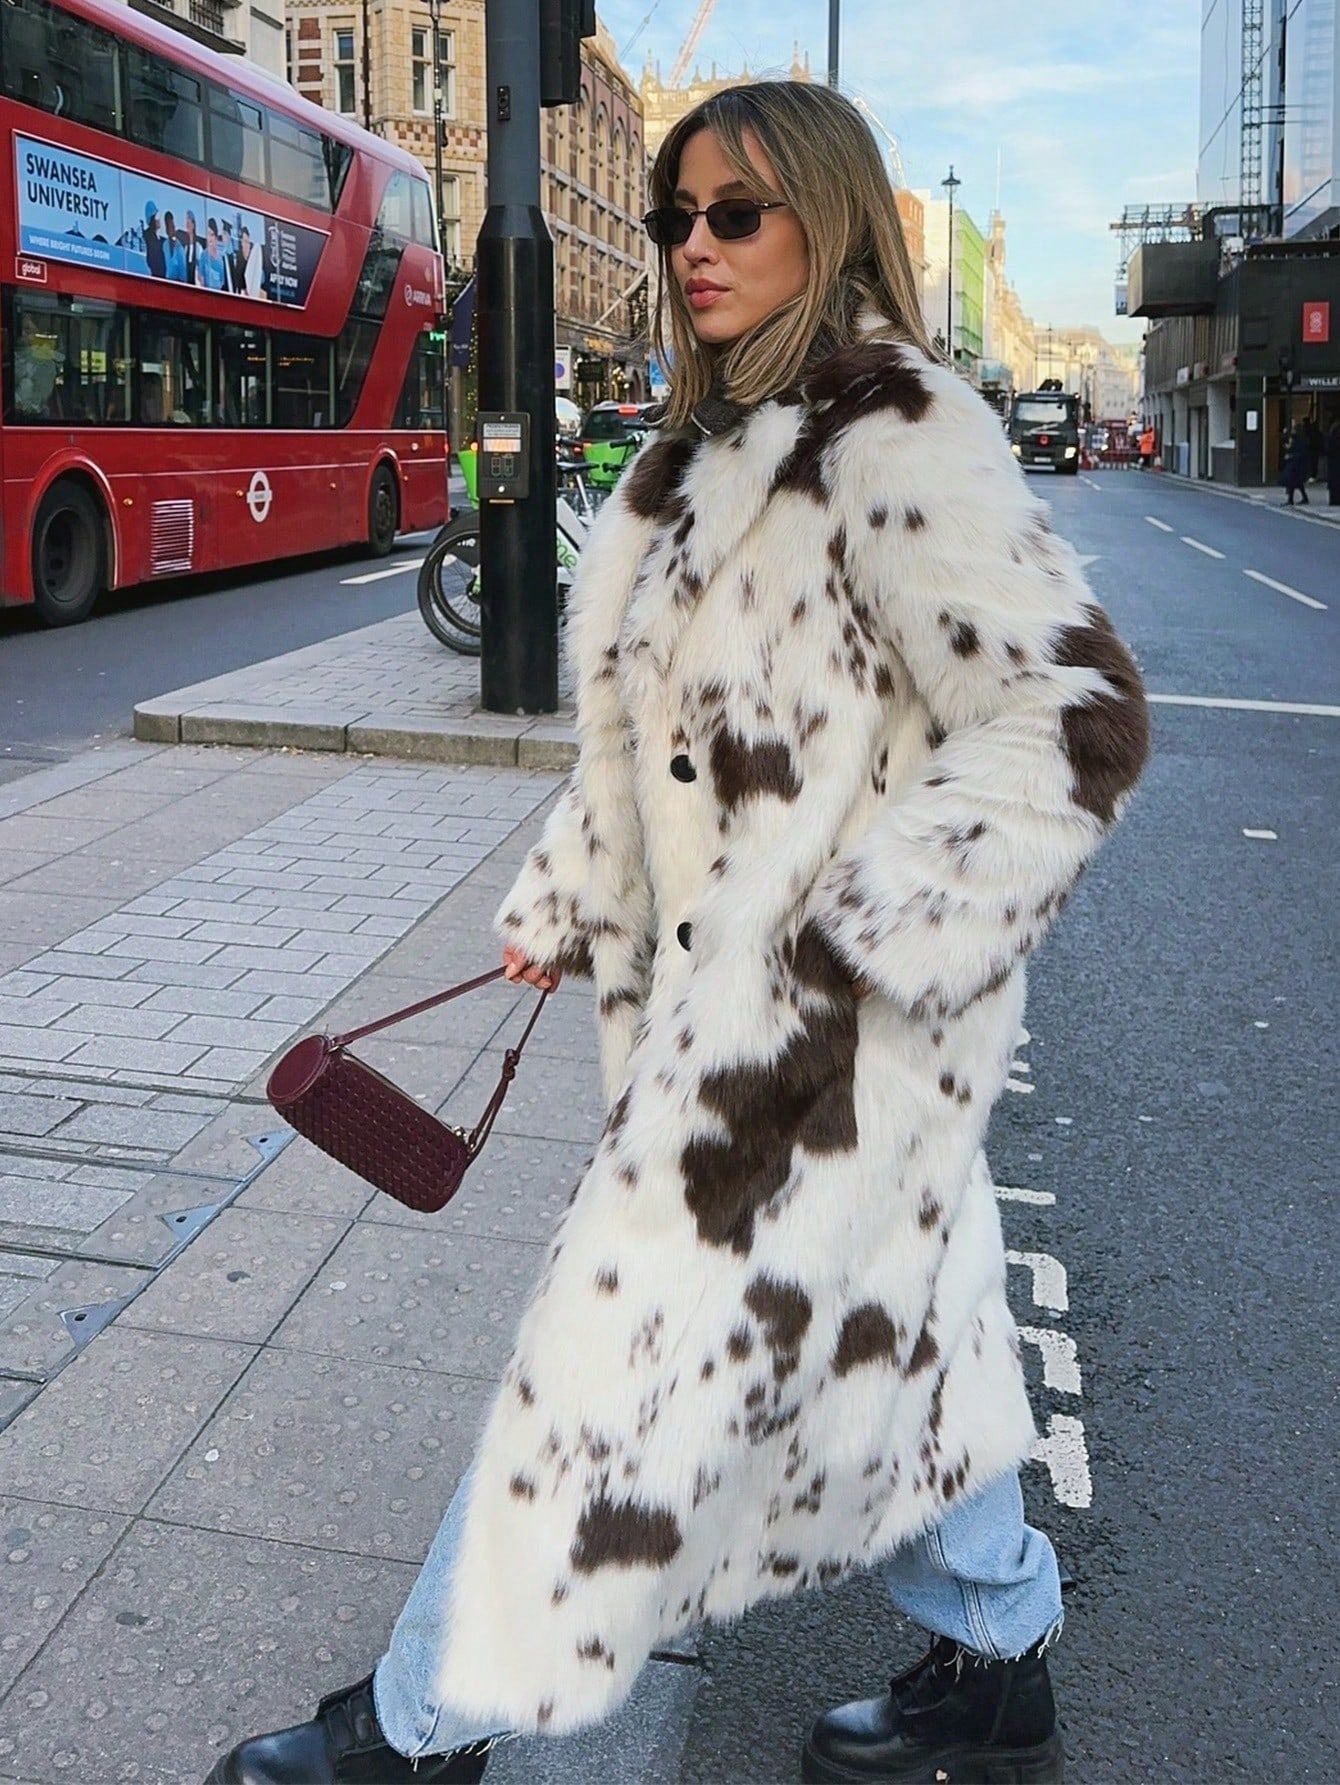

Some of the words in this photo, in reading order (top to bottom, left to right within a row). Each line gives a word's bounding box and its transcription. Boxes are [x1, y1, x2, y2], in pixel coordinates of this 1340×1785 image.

[26, 152, 97, 193] SWANSEA
[27, 180, 109, 221] UNIVERSITY
[22, 262, 42, 277] global
[1309, 377, 1340, 386] WILLE
